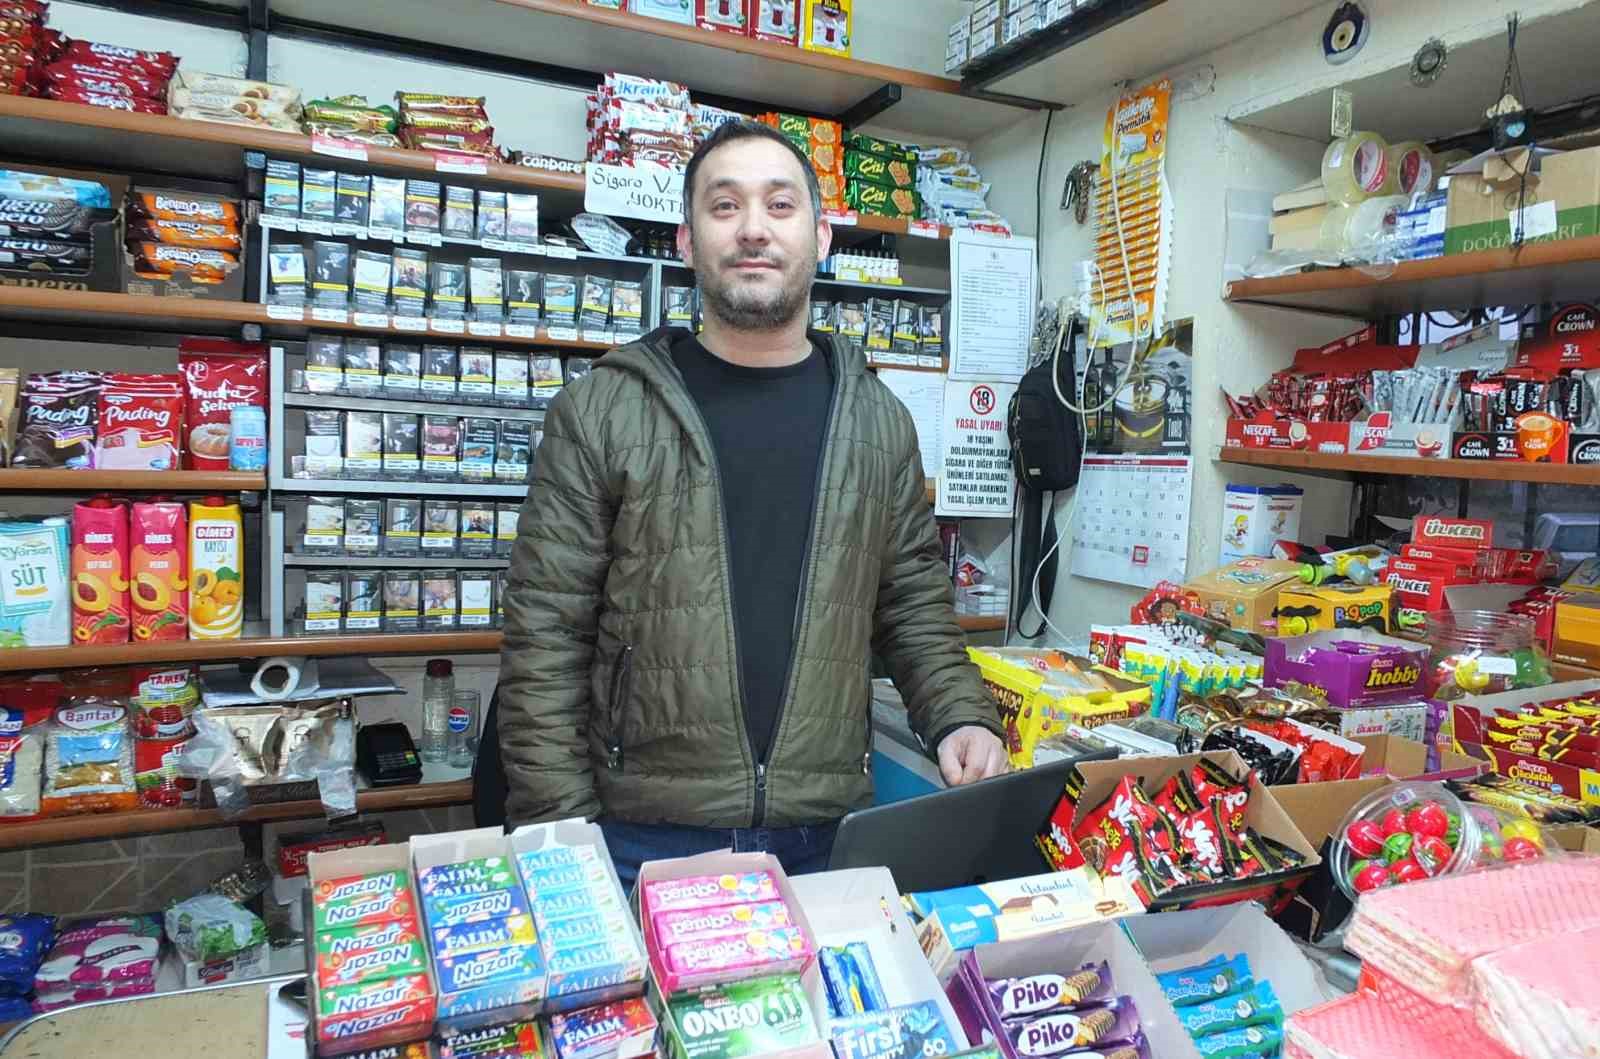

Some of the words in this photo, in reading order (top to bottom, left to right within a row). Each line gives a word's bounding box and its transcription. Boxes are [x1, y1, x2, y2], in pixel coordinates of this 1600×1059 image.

[1557, 320, 1595, 333] CROWN
[28, 405, 90, 426] Puding
[106, 407, 171, 428] Puding
[955, 418, 978, 430] YASAL
[1425, 519, 1484, 540] ÜLKER
[11, 563, 47, 587] SÜT
[1366, 665, 1422, 687] hobby
[65, 710, 117, 724] Bantat
[327, 896, 394, 924] Nazar
[332, 928, 400, 954] Nazar
[444, 927, 506, 949] FALIM
[455, 953, 521, 983] Nazar
[336, 984, 410, 1013] Nazar
[1012, 980, 1059, 1009] Piko
[336, 1005, 412, 1037] Nazar
[563, 1017, 625, 1046] FALIM
[447, 1025, 508, 1048] FALIM
[922, 1038, 948, 1057] 60
